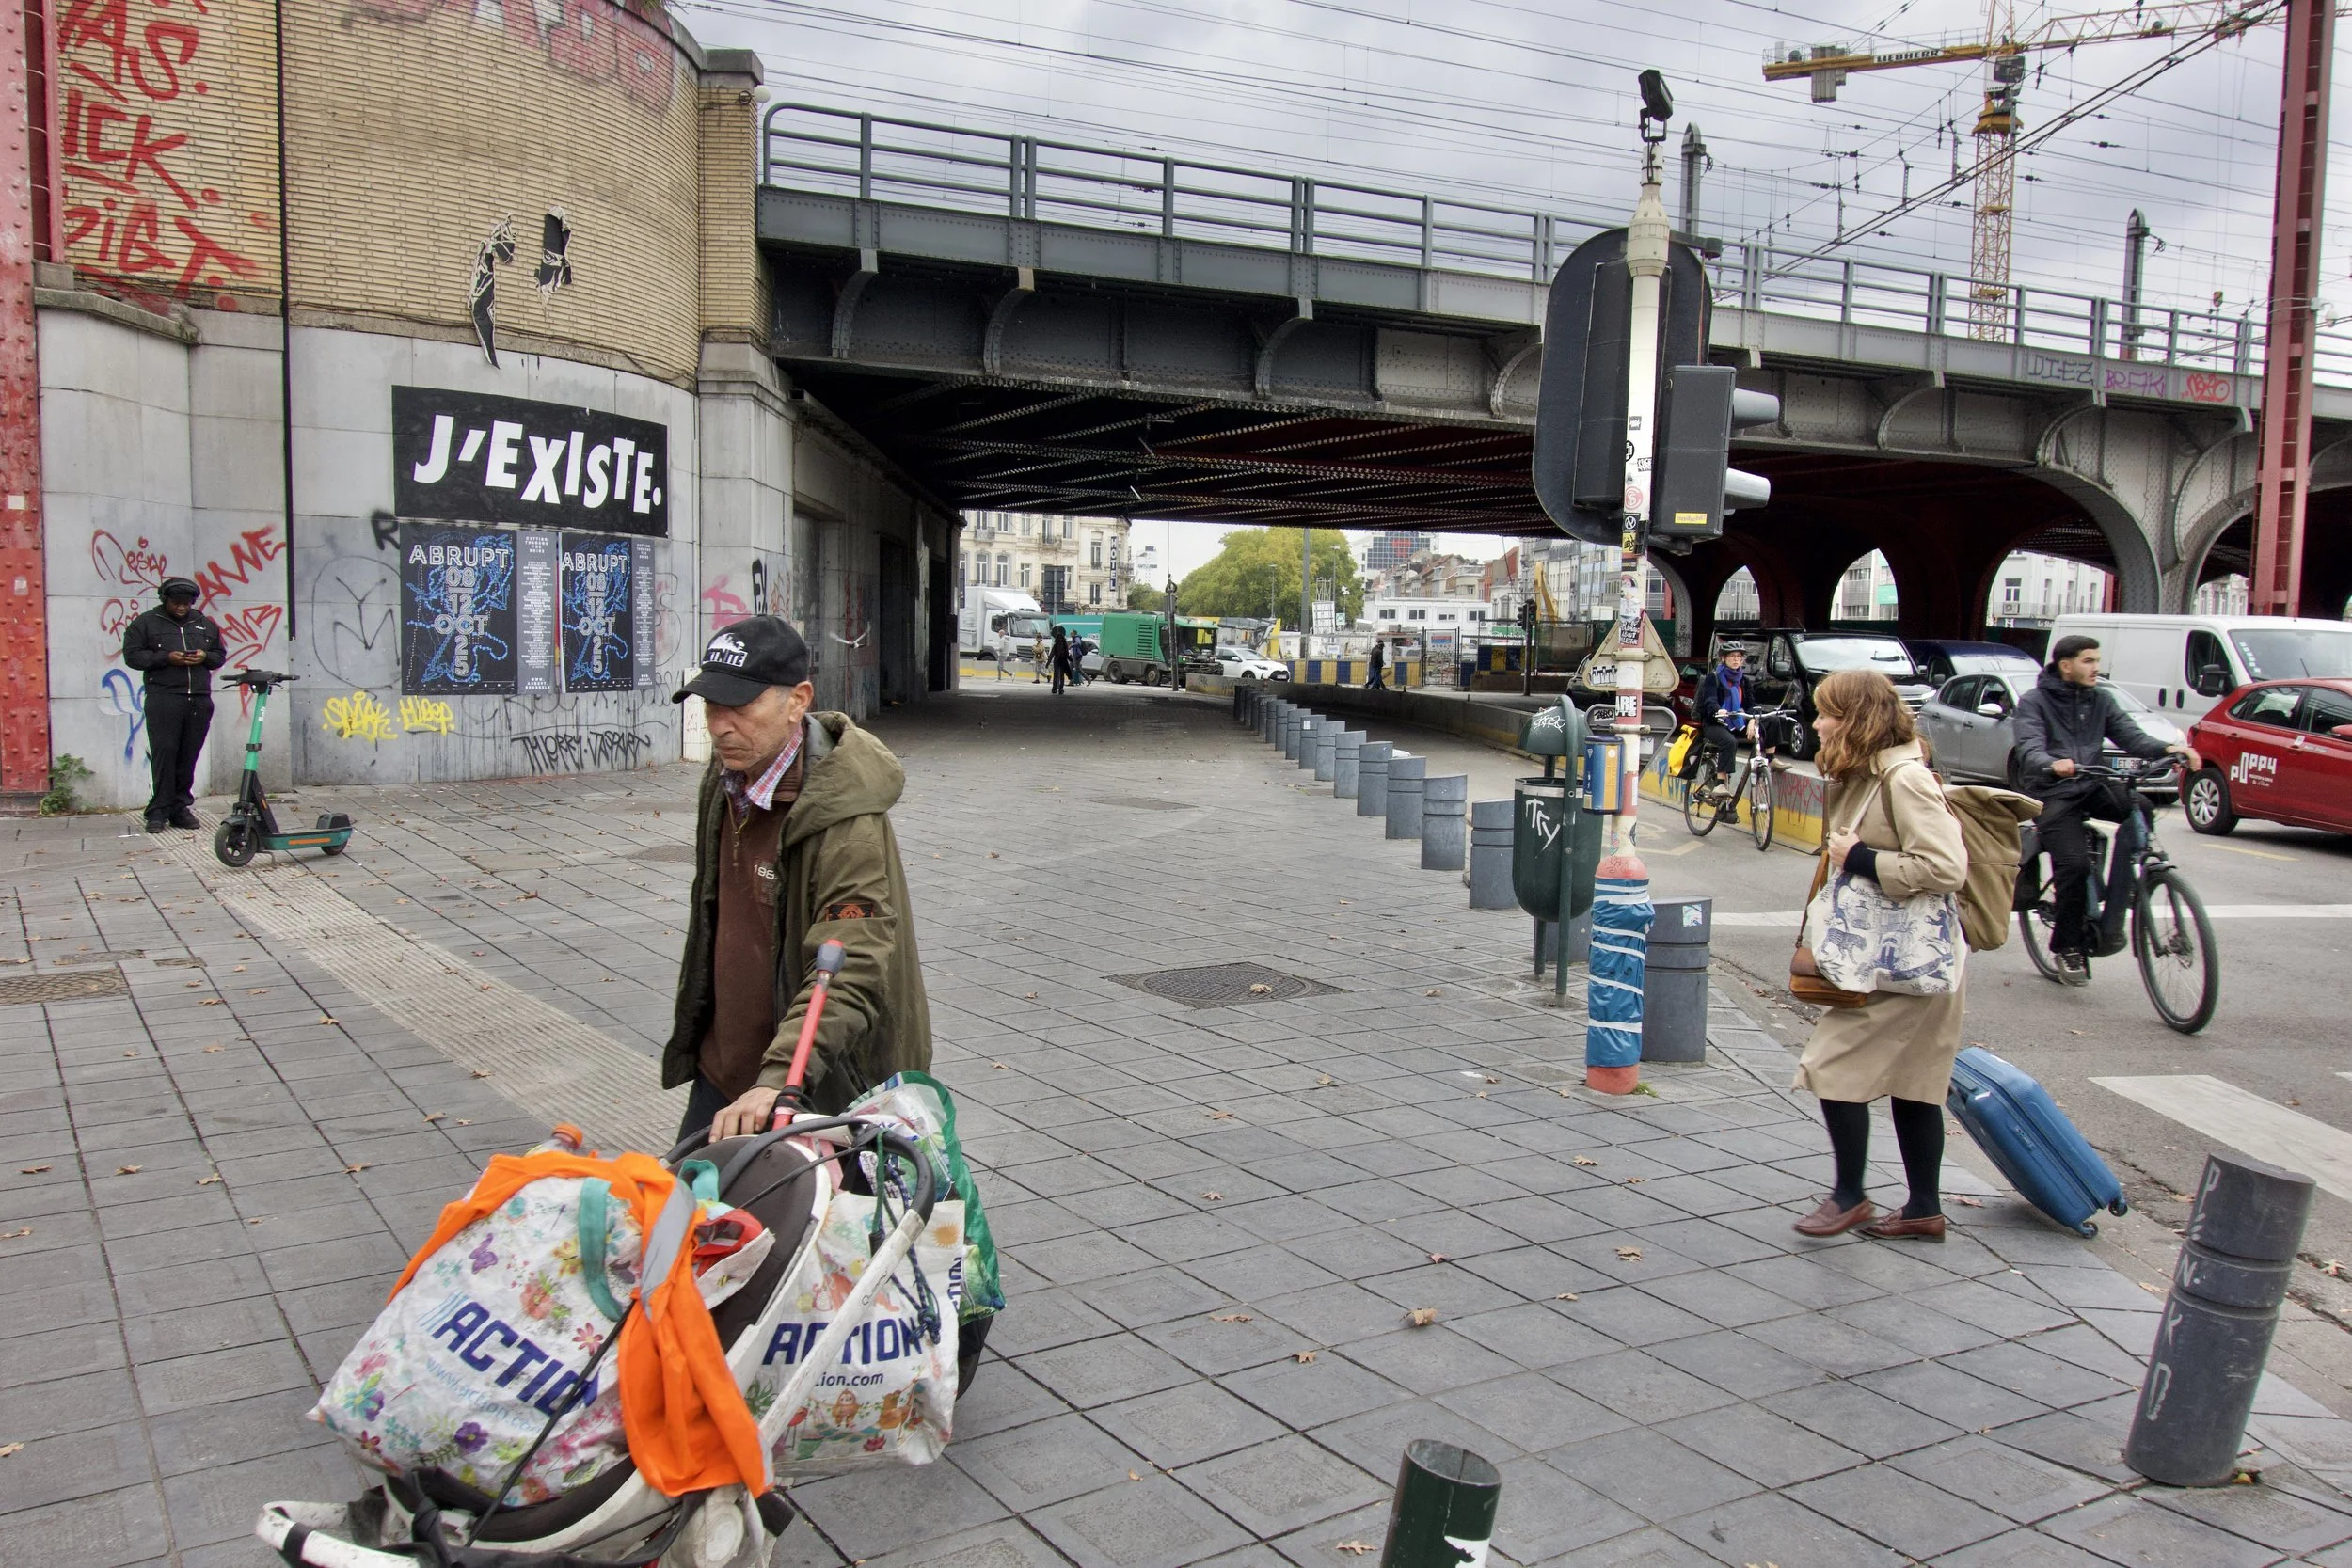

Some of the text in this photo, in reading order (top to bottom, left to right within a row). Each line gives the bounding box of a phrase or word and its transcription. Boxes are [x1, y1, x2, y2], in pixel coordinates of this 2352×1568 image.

[1877, 50, 1940, 62] LIEBHERR
[409, 544, 509, 568] ABRUPT
[562, 551, 628, 573] ABRUPT
[1109, 535, 1118, 592] HOTEL
[446, 566, 477, 587] 08
[450, 594, 473, 615] 12
[588, 597, 605, 617] 12
[434, 613, 489, 636] OCT
[579, 616, 616, 636] OCT
[814, 1372, 884, 1387] ion.com
